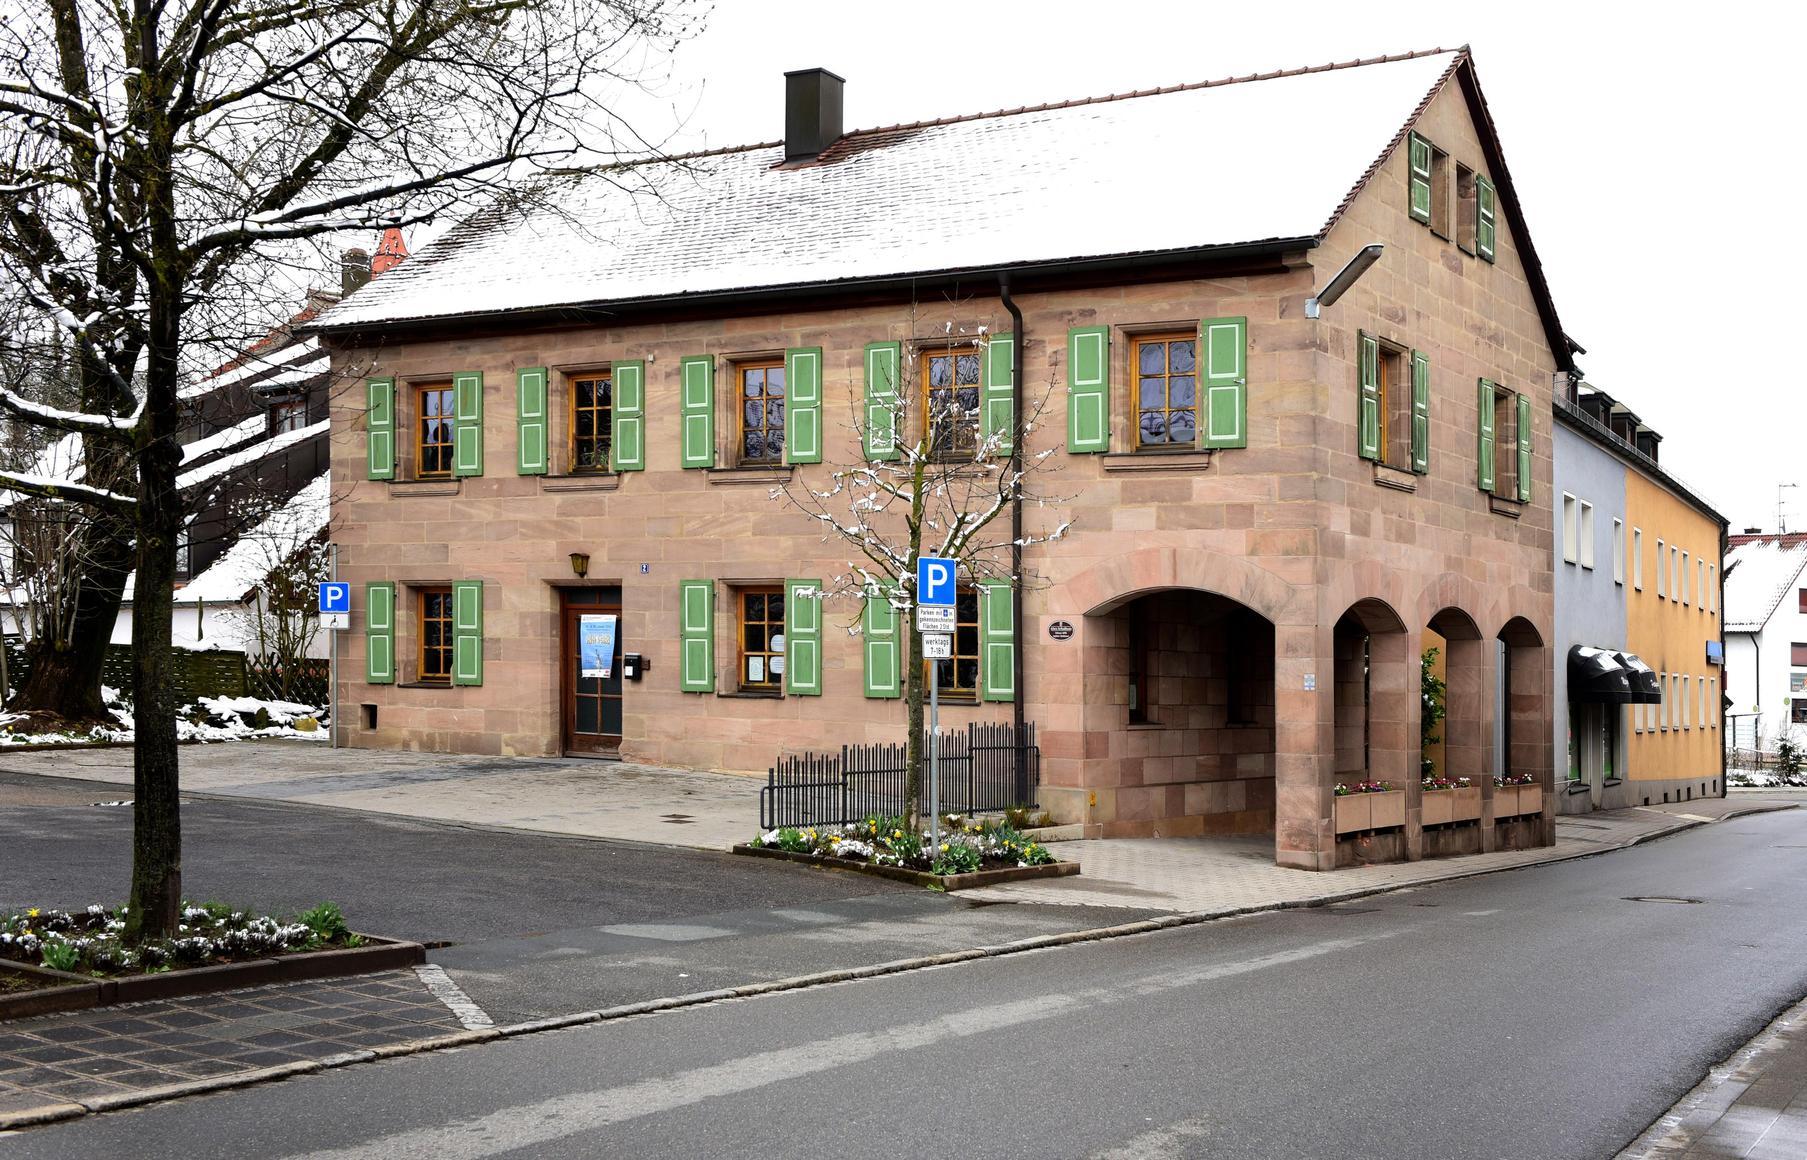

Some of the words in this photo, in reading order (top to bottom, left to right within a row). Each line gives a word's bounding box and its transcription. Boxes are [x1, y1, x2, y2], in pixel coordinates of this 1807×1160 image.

[928, 564, 948, 598] P
[327, 586, 343, 608] P
[925, 638, 949, 647] werktags
